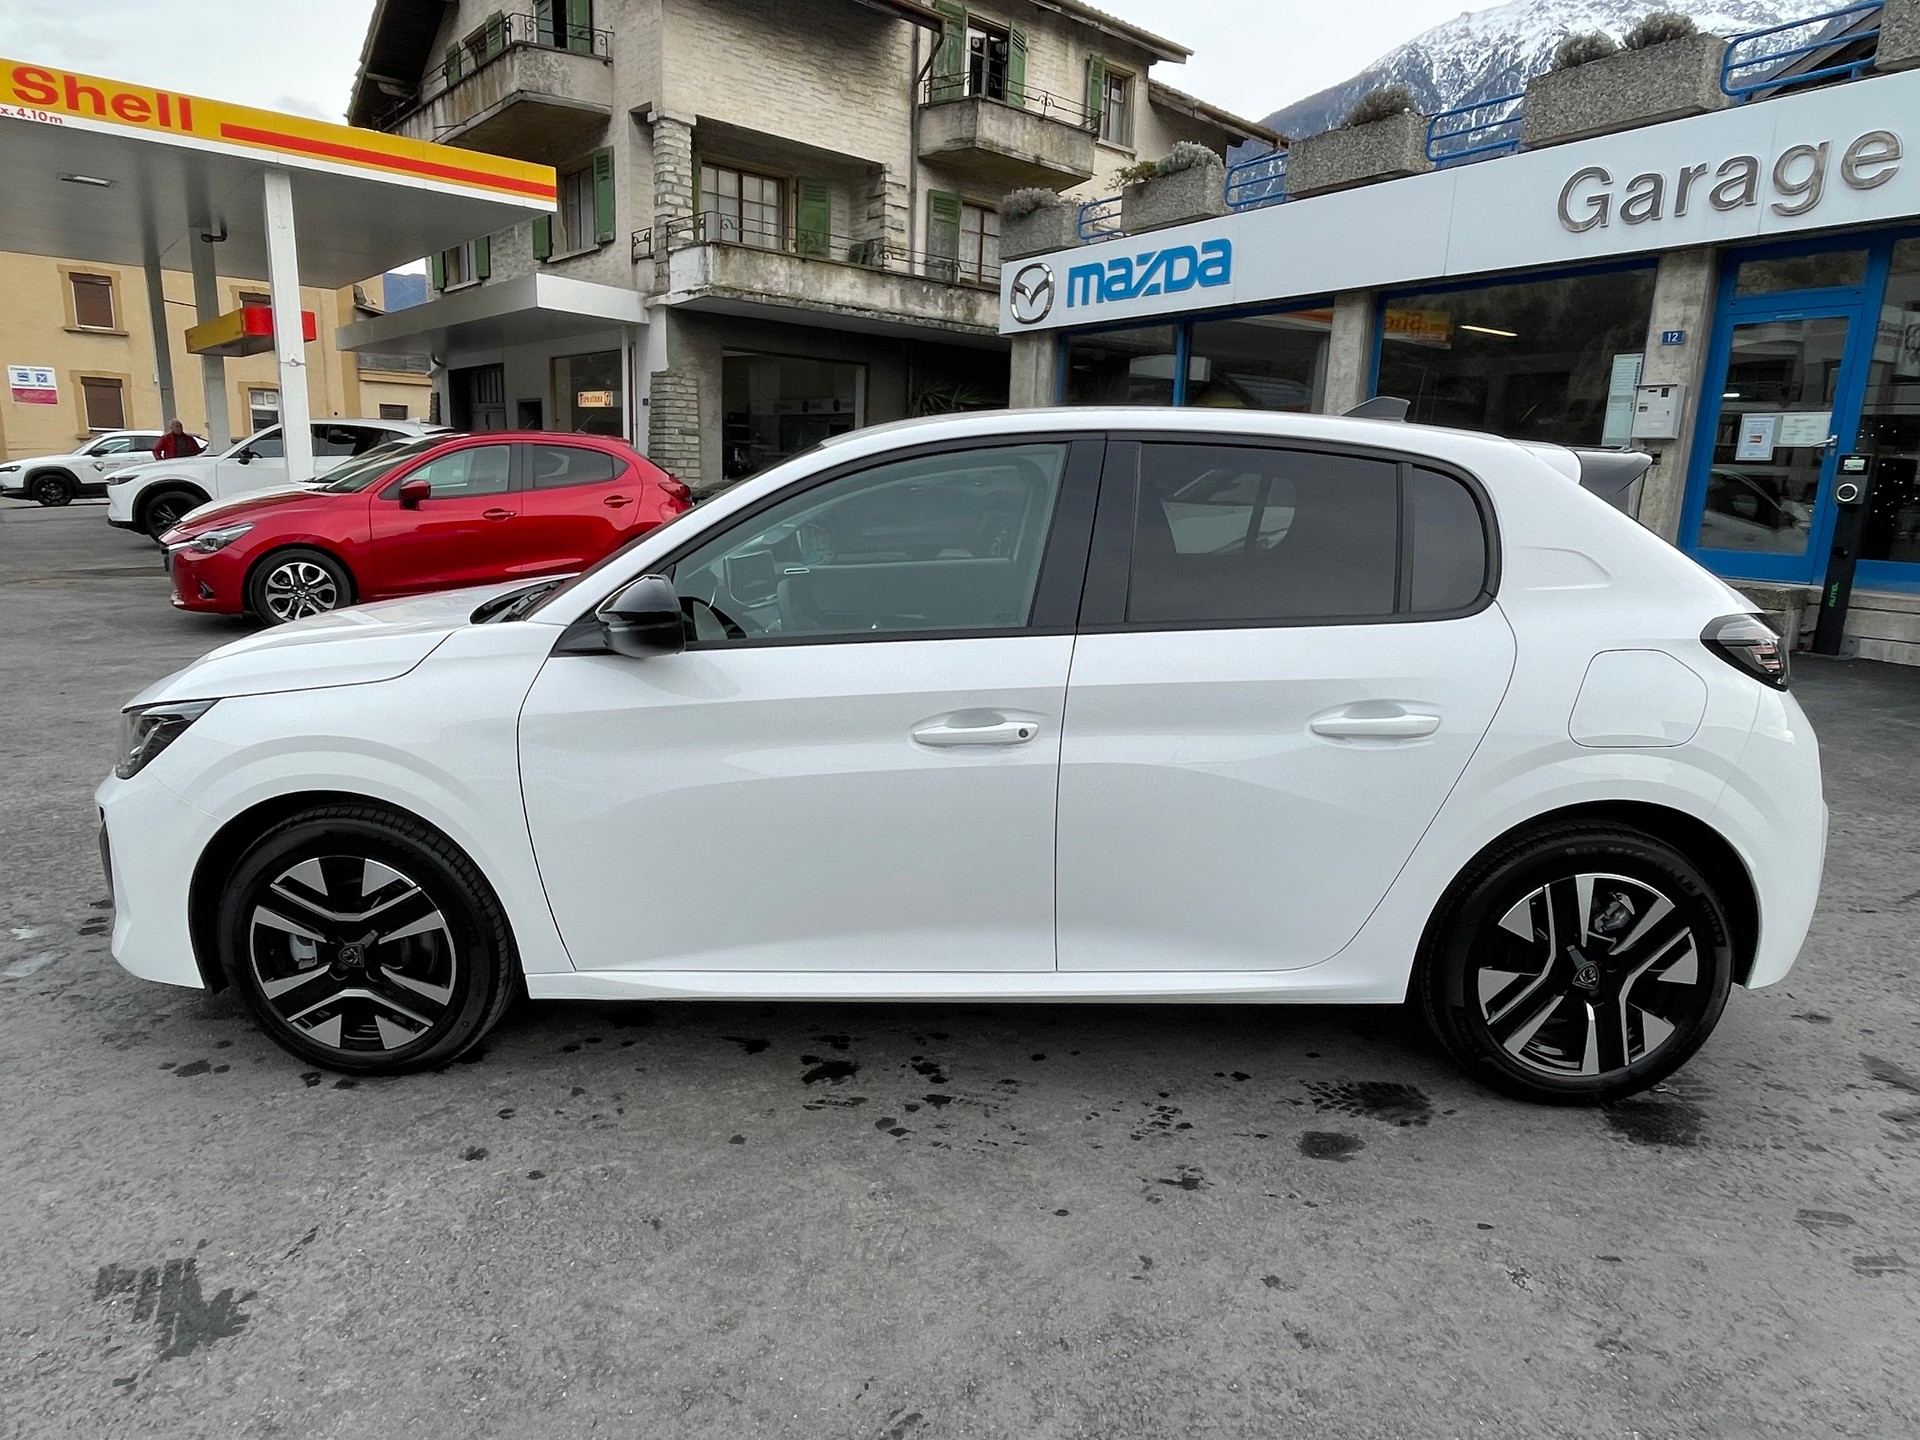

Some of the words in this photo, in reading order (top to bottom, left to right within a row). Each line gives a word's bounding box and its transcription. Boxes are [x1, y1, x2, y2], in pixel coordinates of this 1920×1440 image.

[12, 66, 193, 132] Shell
[1557, 129, 1904, 233] Garage
[1667, 332, 1679, 343] 12
